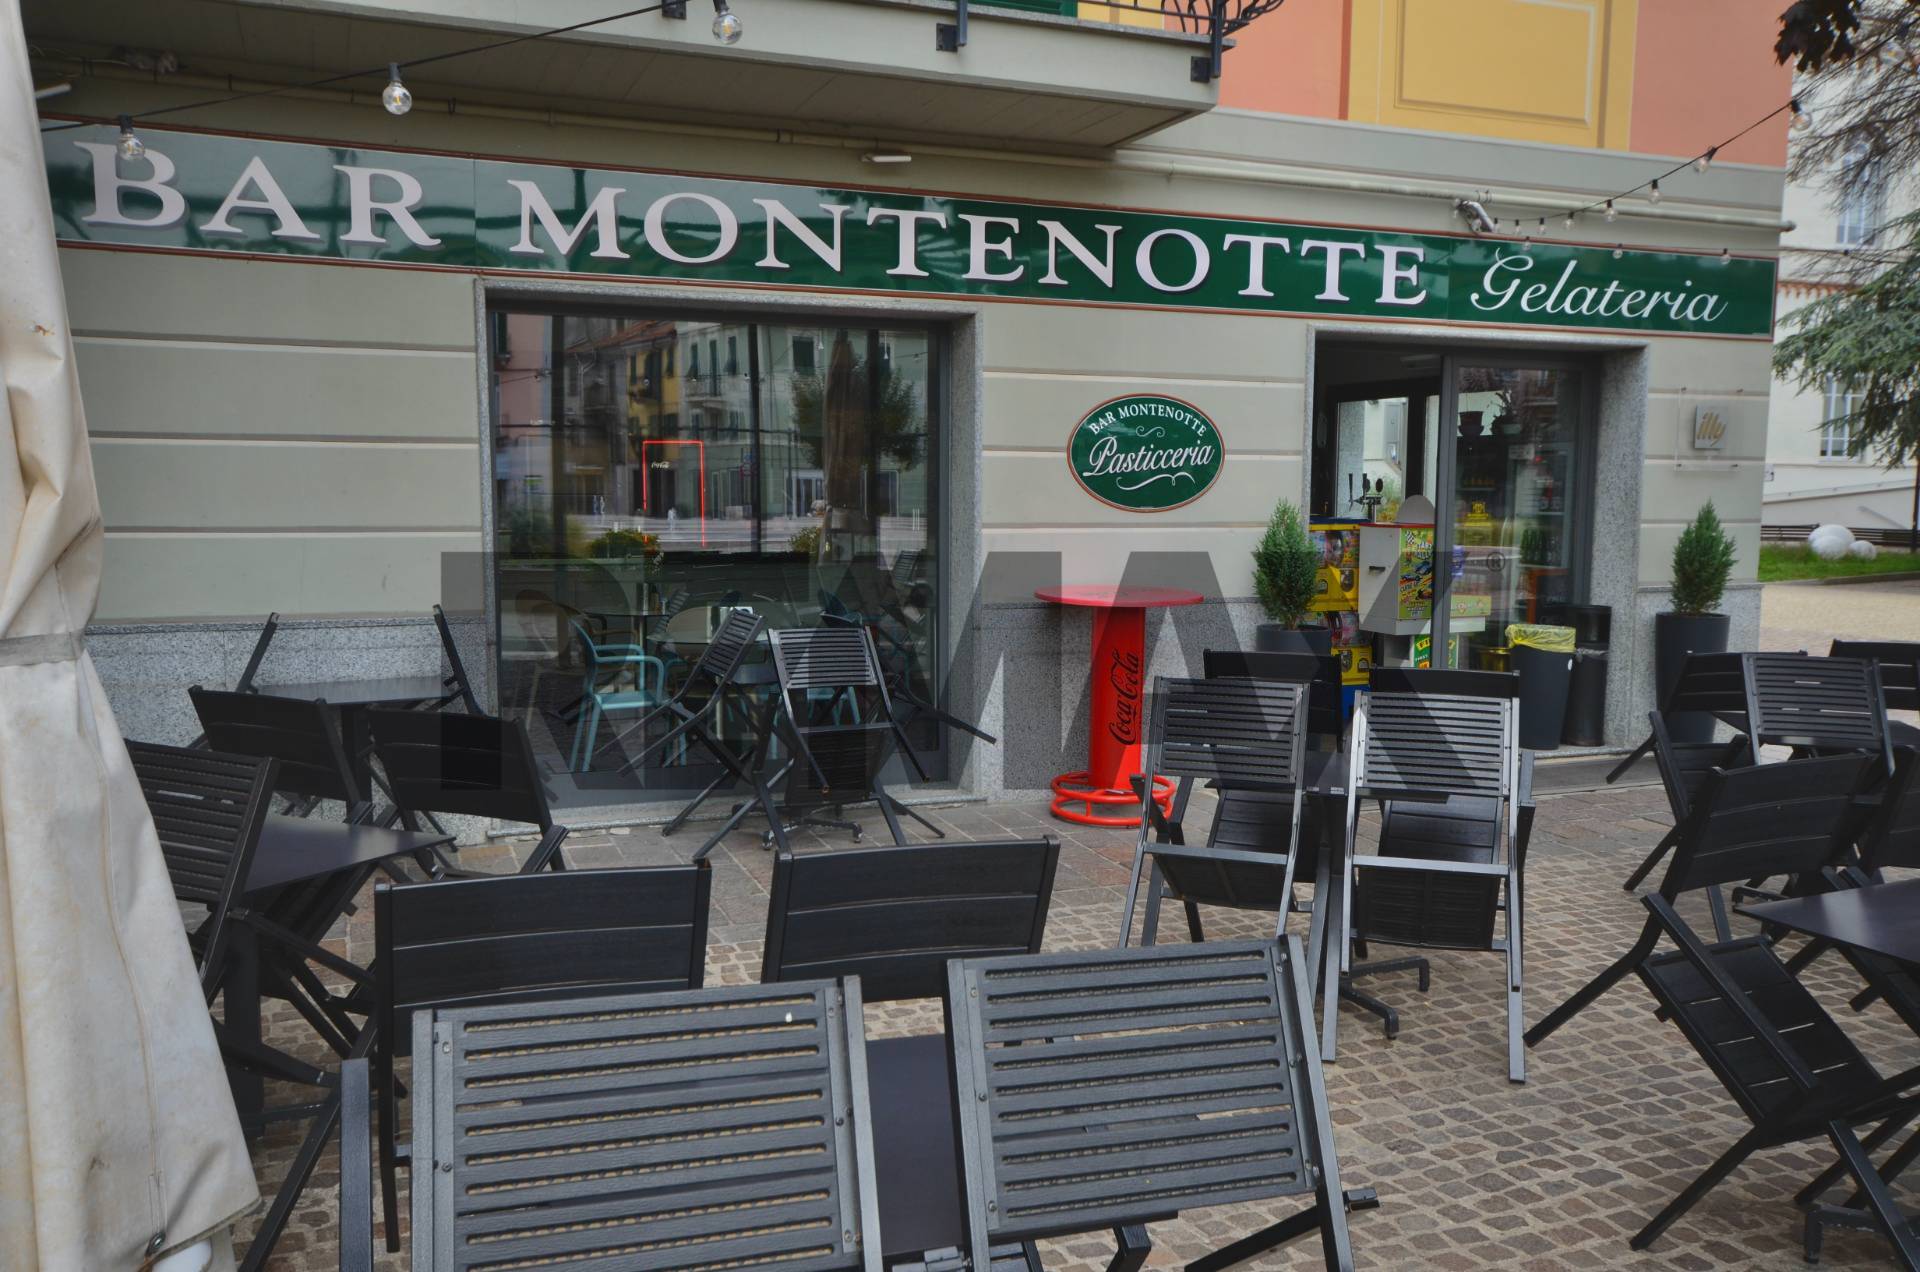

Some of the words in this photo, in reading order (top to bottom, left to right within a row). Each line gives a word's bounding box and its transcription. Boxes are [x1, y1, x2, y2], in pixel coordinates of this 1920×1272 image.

[73, 140, 443, 247] BAR
[506, 178, 1428, 306] MONTENOTTE
[1470, 247, 1728, 322] Gelateria
[1088, 411, 1116, 434] BAR
[1118, 403, 1207, 437] MONTENOTTE
[1082, 435, 1215, 477] Pasticceria
